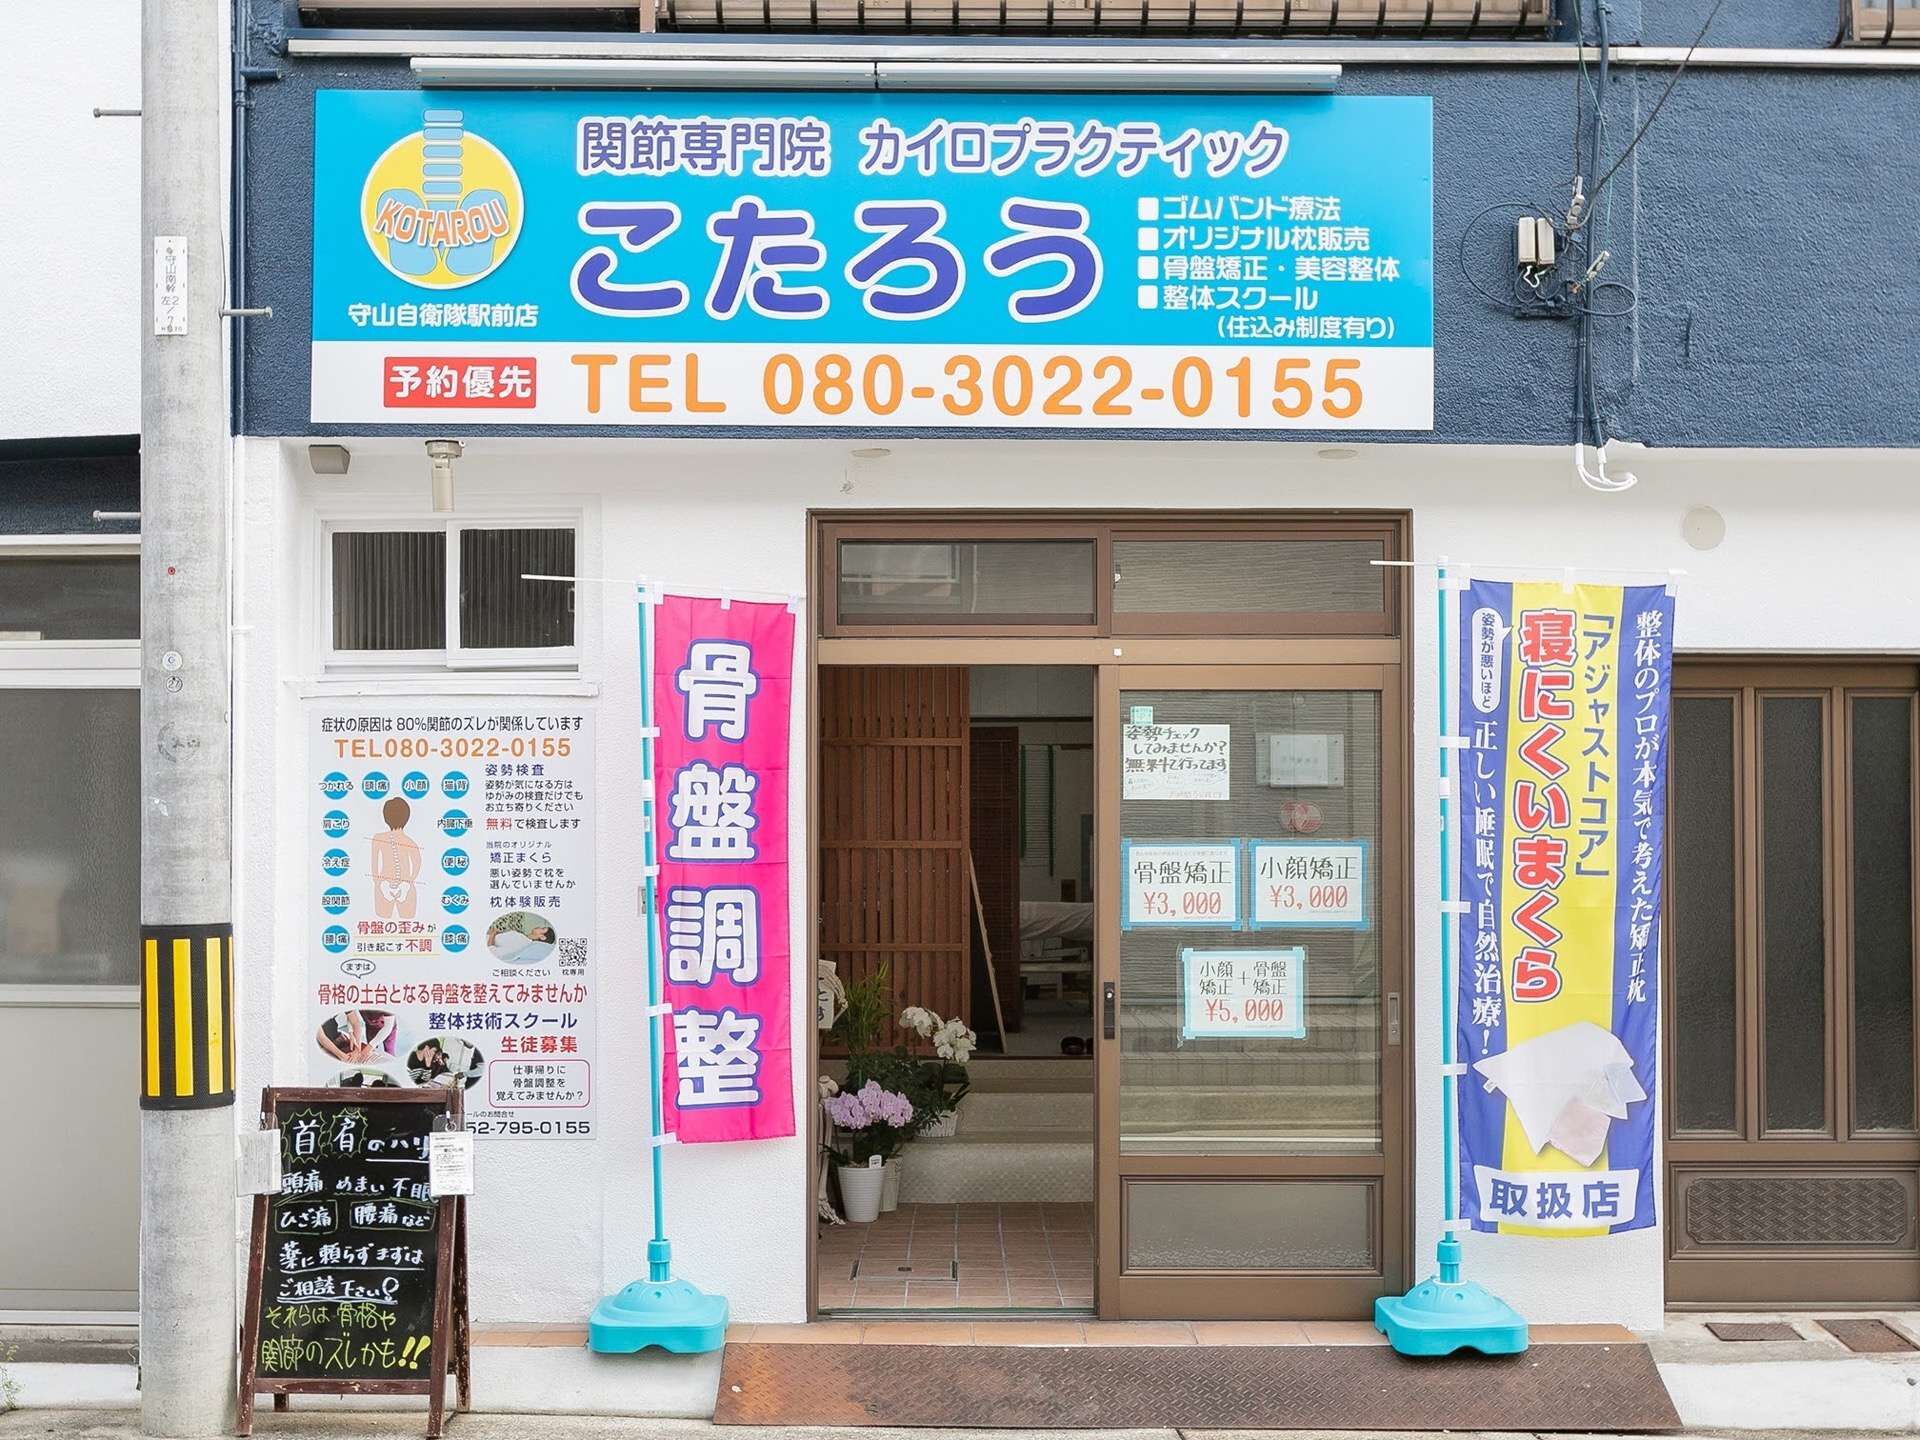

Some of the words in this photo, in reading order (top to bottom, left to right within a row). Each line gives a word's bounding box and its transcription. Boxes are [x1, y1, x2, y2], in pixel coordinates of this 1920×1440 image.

[580, 119, 829, 174] 関節専門院
[861, 119, 1287, 175] カイロプラクティック
[1162, 196, 1341, 222] ゴムバンド療法
[374, 199, 510, 247] KOTAROU
[1162, 226, 1371, 251] オリジナル枕販売
[573, 198, 1102, 320] こたろう
[1162, 255, 1400, 282] 骨盤矯正・美容整体
[1162, 285, 1319, 310] 整体スクール
[347, 303, 540, 328] 守山自衛隊駅前店
[388, 365, 533, 401] 予約優先
[570, 354, 727, 415] TEL
[762, 353, 1364, 419] 080-3022-0155
[1479, 612, 1496, 709] 姿勢が悪いほど
[321, 717, 392, 733] 症状の原因は
[1125, 725, 1200, 741] 姿勢チェック
[334, 737, 572, 758] TEL080-3022-0155
[485, 763, 545, 776] 姿勢検査
[318, 781, 354, 791] つかれる
[364, 780, 389, 791] 頭痛
[404, 780, 428, 791] 小顔
[485, 780, 573, 790] 姿勢が気になる方は
[485, 791, 584, 801] ゆがみの検査だけでも
[485, 802, 574, 812] お立ち寄りください
[1511, 608, 1577, 1002] 寝にくいまくら
[1626, 611, 1664, 1005] 整体のプロが本気で考えた矯正枕
[322, 819, 350, 829] 肩こり
[443, 857, 468, 868] 便秘
[489, 852, 552, 864] 矯正まくら
[489, 868, 565, 878] 悪い姿勢で枕を
[666, 639, 760, 1108] 骨盤調整
[1134, 861, 1232, 884] 骨盤矯正
[1260, 856, 1359, 880] 小顔矯正
[489, 879, 576, 889] 選んでいませんか
[441, 895, 470, 905] むくみ
[489, 896, 561, 908] 枕体験販売
[357, 921, 437, 935] 骨盤の歪みが
[356, 938, 433, 953] 引き起こす不調
[345, 963, 371, 971] まずは
[492, 968, 551, 977] ご相談ください
[1200, 961, 1233, 978] 小顔
[1253, 961, 1287, 978] 骨盤
[318, 983, 588, 1005] 骨格の土台となる骨盤を整えてみませんか
[1200, 979, 1233, 996] 矯正
[1253, 979, 1287, 996] 矯正
[428, 1012, 578, 1030] 整体技術スクール
[500, 1036, 579, 1054] 生徒募集
[512, 1065, 567, 1075] 仕事帰りに
[512, 1078, 566, 1088] 骨盤調整を
[293, 1119, 320, 1155] 首
[333, 1117, 356, 1153] 肩
[281, 1169, 323, 1195] 頭痛
[335, 1176, 385, 1192] めまい
[1489, 1178, 1620, 1219] 取扱店
[280, 1206, 332, 1228] ひざ痛
[354, 1202, 430, 1227] 腰痛など
